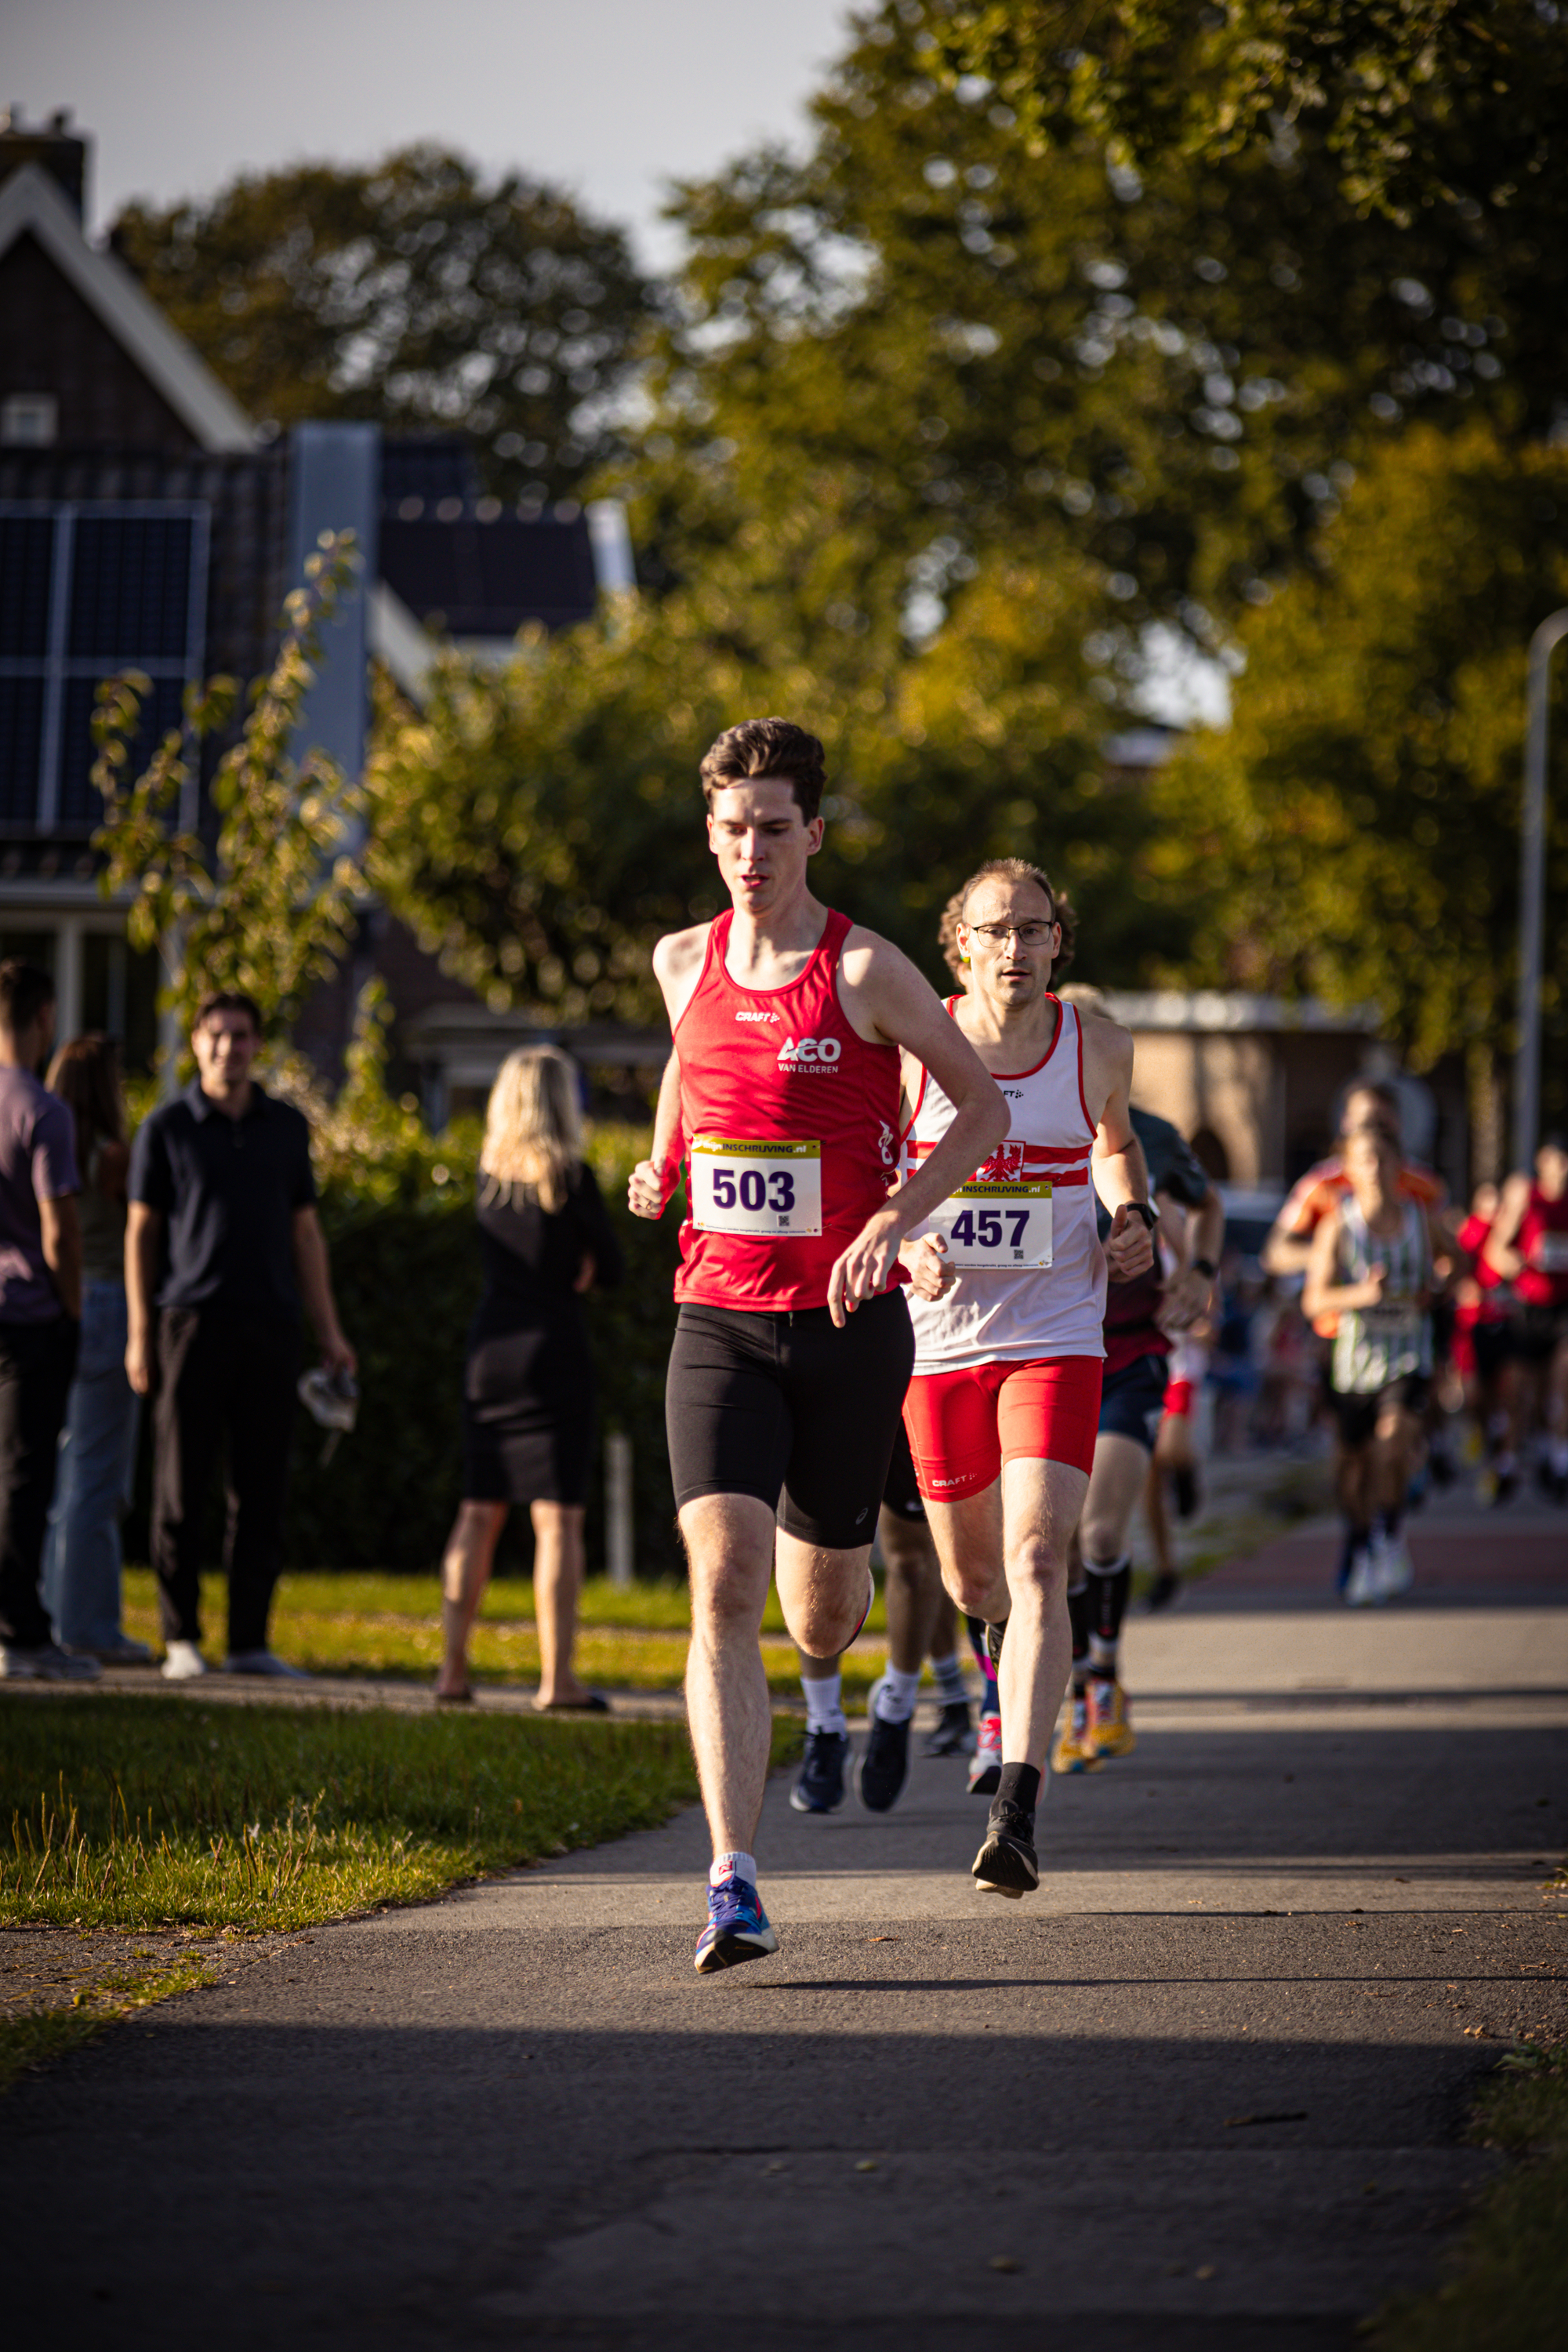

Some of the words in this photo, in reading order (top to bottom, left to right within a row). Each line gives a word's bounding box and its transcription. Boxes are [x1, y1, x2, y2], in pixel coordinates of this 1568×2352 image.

[735, 1011, 771, 1022] CRAFT
[777, 1036, 841, 1062] ACO
[778, 1063, 796, 1073] VAN
[798, 1064, 838, 1074] ELDEREN
[713, 1168, 795, 1212] 503
[950, 1210, 1030, 1248] 457
[932, 1475, 967, 1487] CRAFT
